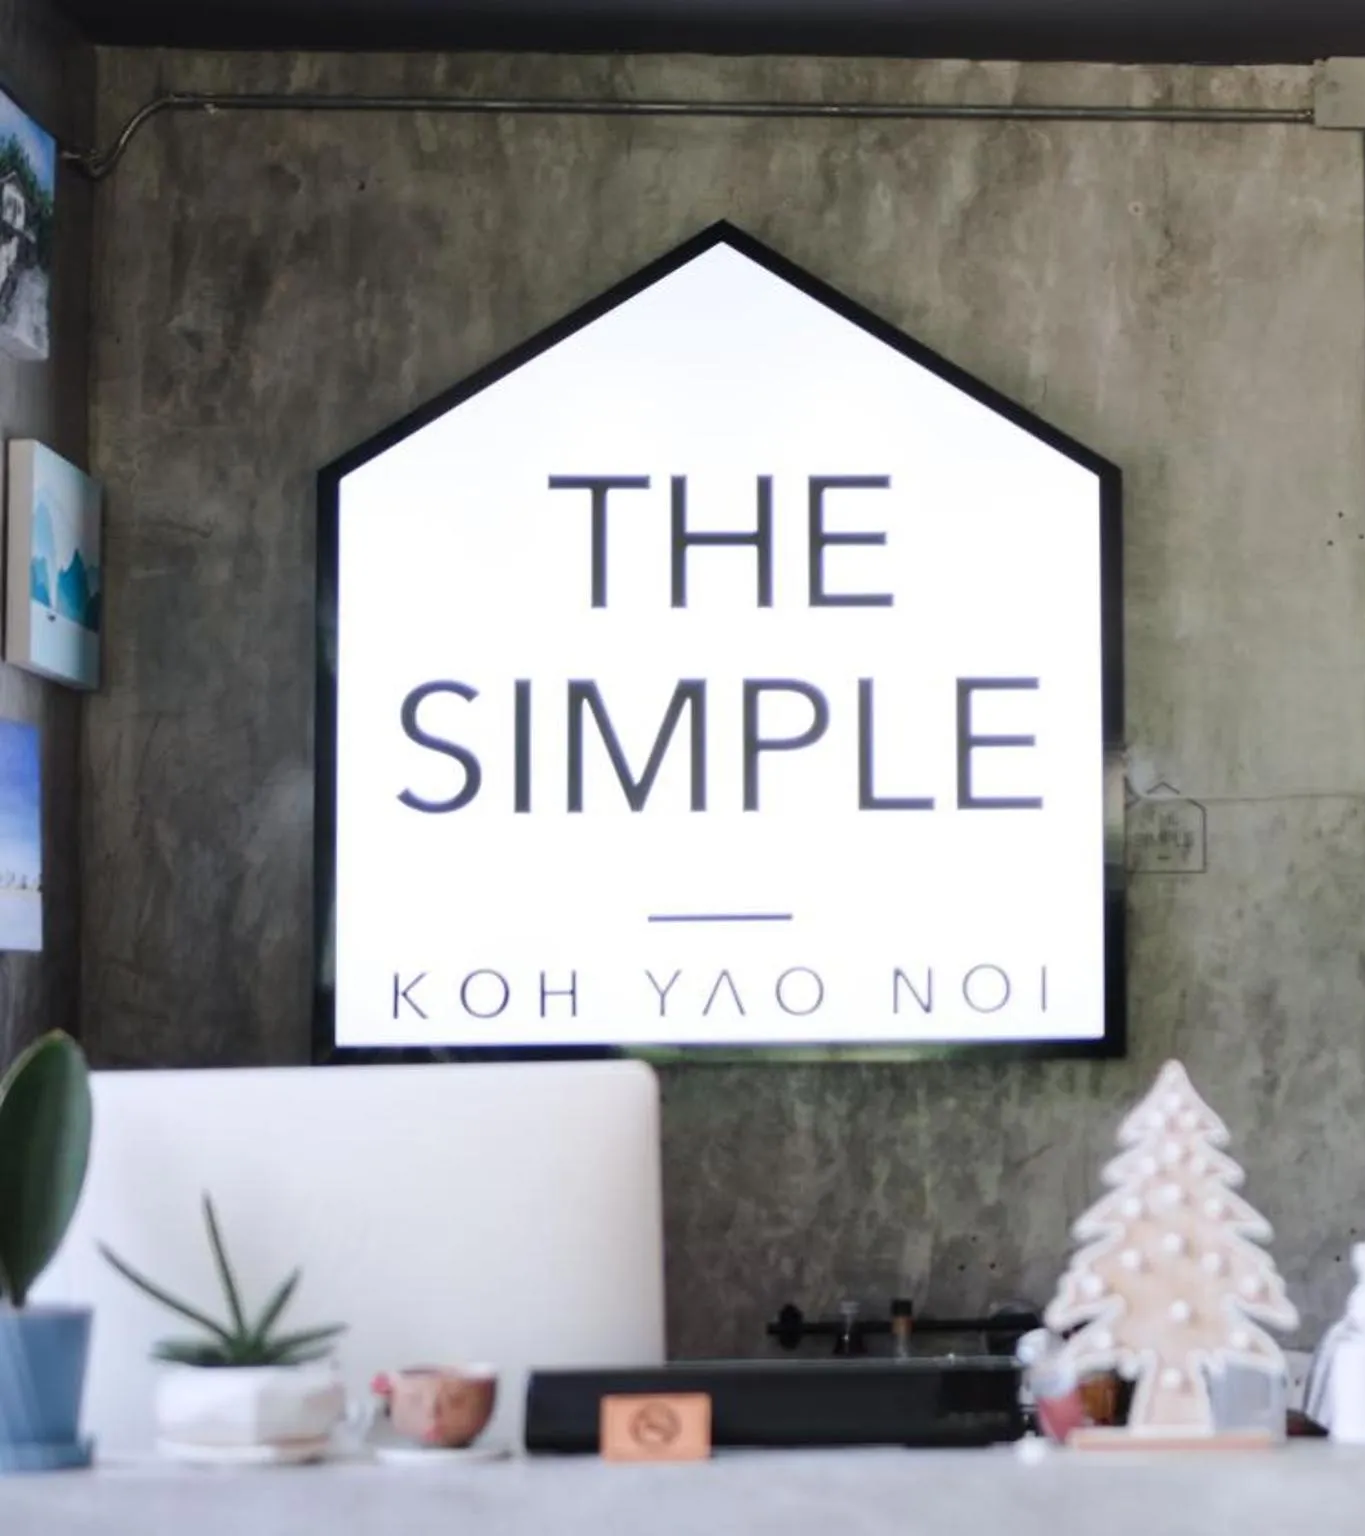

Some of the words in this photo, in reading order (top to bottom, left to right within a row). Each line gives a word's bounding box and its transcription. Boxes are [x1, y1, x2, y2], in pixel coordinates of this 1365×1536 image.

[548, 474, 893, 609] THE
[398, 677, 1042, 814] SIMPLE
[392, 970, 577, 1020] KOH
[893, 965, 1048, 1014] NOI
